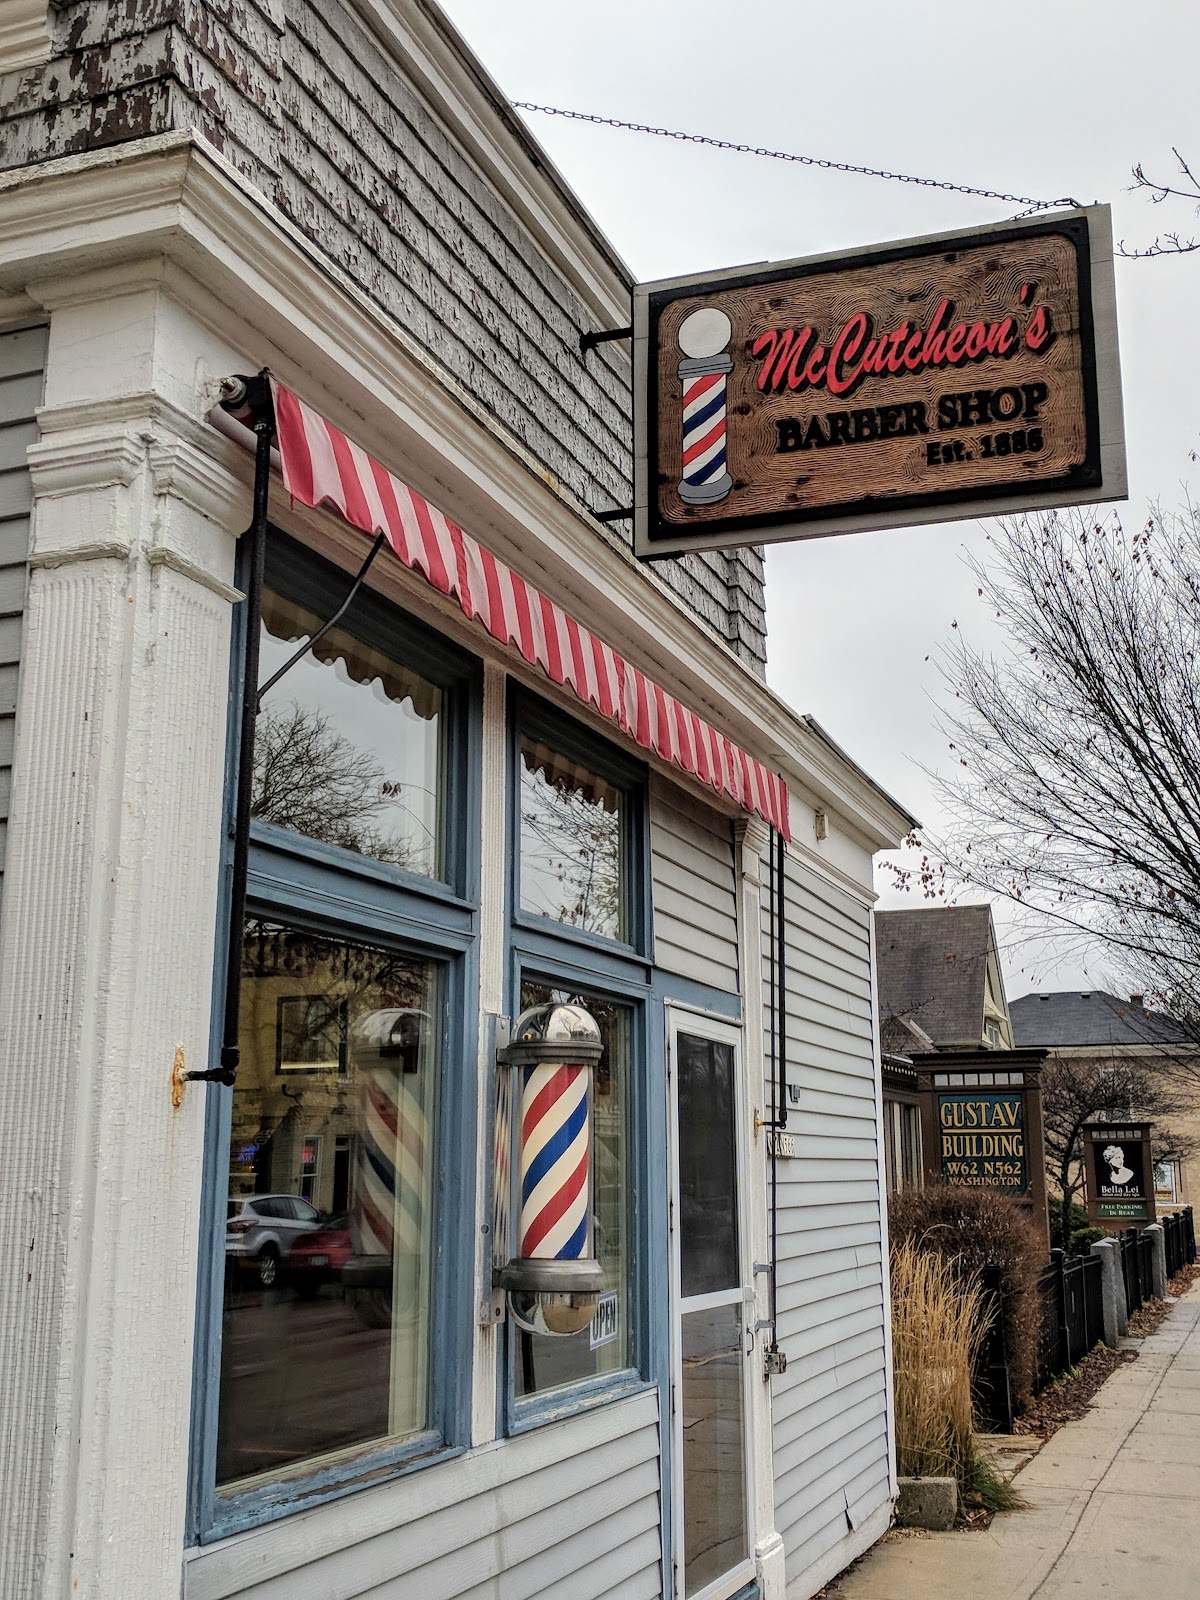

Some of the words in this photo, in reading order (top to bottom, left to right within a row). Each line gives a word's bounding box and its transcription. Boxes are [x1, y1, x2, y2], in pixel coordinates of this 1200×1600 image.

[752, 283, 1051, 395] McCutcheon's
[776, 401, 930, 453] BARBER
[938, 383, 1049, 432] SHOP
[940, 1102, 1021, 1127] GUSTAV
[942, 1135, 1024, 1157] BUILDING
[947, 1162, 978, 1175] W62
[983, 1162, 1021, 1175] N562
[949, 1177, 1020, 1186] WASHINGTON
[1101, 1185, 1123, 1194] Bella
[592, 1297, 616, 1341] OPEN
